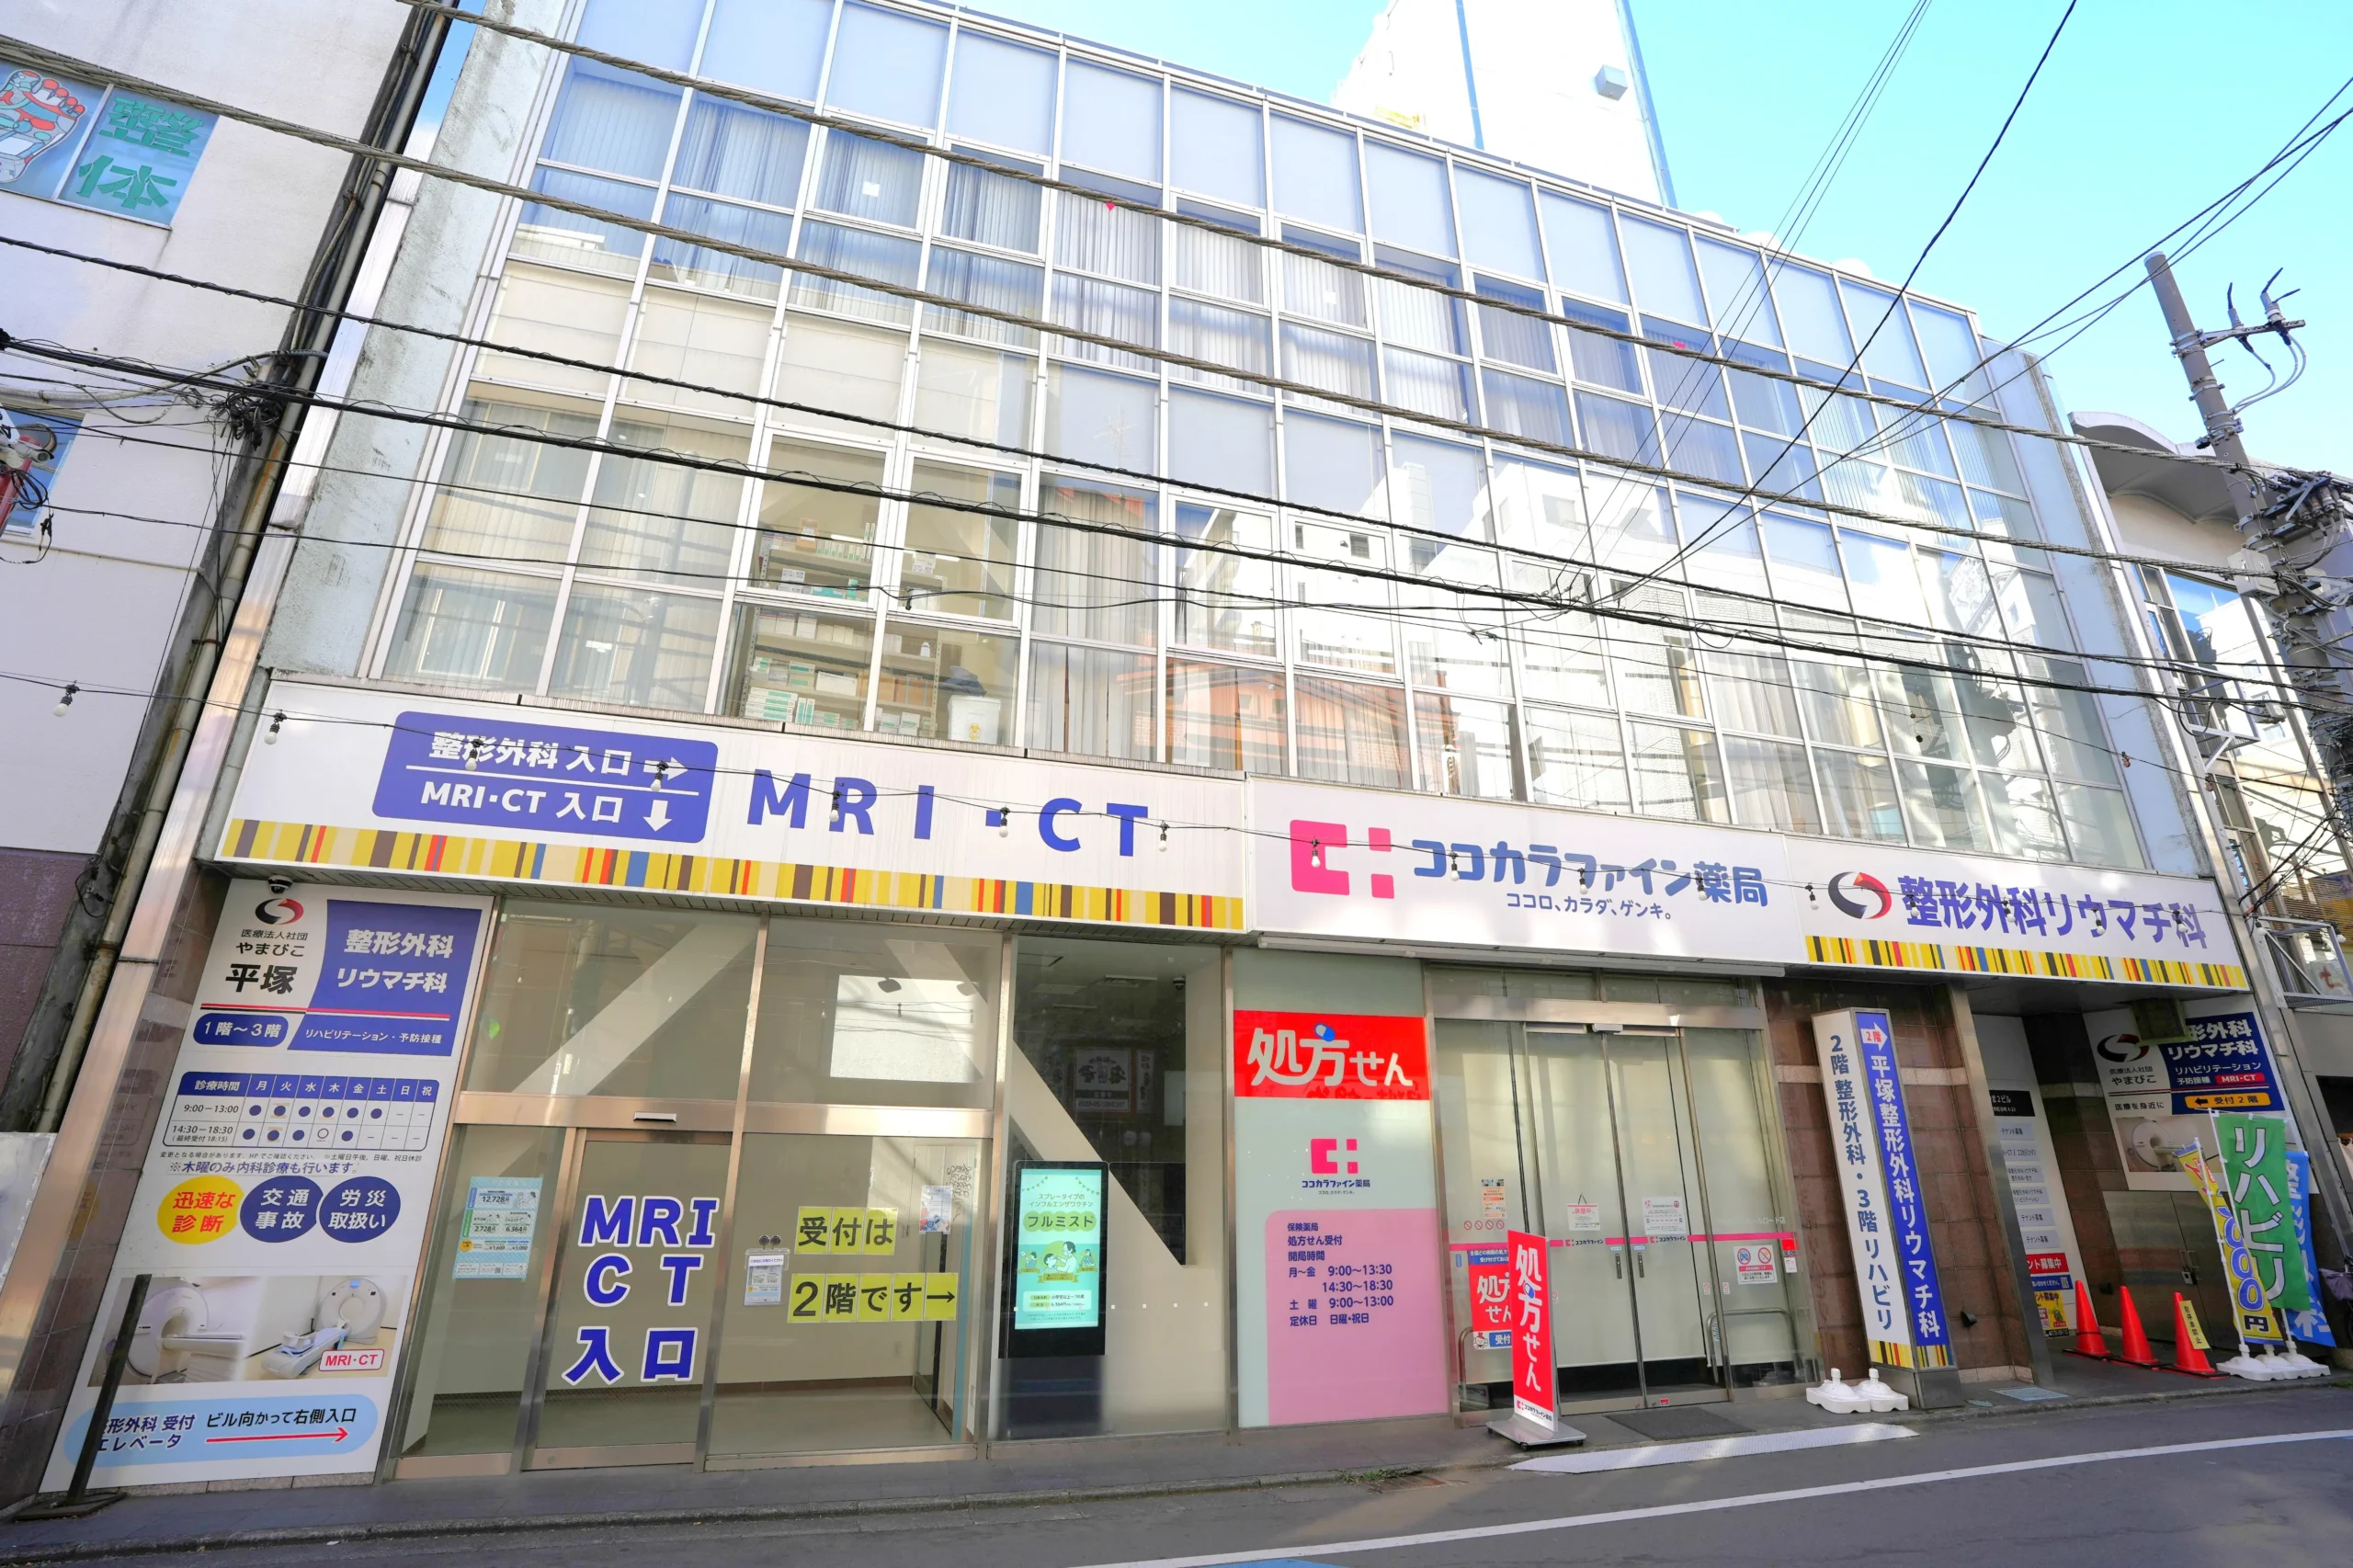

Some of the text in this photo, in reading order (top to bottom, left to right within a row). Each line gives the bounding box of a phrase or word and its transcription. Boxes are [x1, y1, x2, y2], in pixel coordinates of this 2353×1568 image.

[429, 732, 631, 776] 整形外科 入口
[557, 792, 622, 823] 入口
[1413, 839, 1768, 906] ココカラファイン薬局
[1506, 893, 1671, 920] ココロ、カラダ、ゲンキ。
[1897, 875, 2206, 949] 整形外科リウマチ科
[241, 929, 307, 940] 医療法人社団
[344, 929, 454, 958] 整形外科
[236, 942, 304, 957] やまびこ
[225, 964, 298, 994] 平塚
[336, 968, 448, 993] リウマチ科
[1866, 1030, 1881, 1043] 2階
[2188, 1018, 2253, 1041] 形外科
[1247, 1023, 1413, 1086] 処方せん
[2167, 1040, 2259, 1061] リウマチ科
[2109, 1066, 2153, 1075] 医療法人社団
[2175, 1062, 2262, 1075] リハビリテーション
[194, 1080, 432, 1096] 診療時間 月 火 水 木 金 土 日 祝
[2111, 1075, 2157, 1085] やまびこ
[2177, 1076, 2211, 1085] 予防接種
[2114, 1102, 2165, 1111] 医療を身近に
[1302, 1179, 1370, 1188] ココカラファイン薬局
[173, 1191, 235, 1210] 迅速な
[261, 1188, 308, 1207] 交通
[340, 1189, 386, 1207] 労災
[1871, 1055, 1941, 1339] 平塚整形外科リウマチ科
[172, 1214, 224, 1233] 診断
[255, 1210, 305, 1230] 事故
[328, 1211, 387, 1229] 取扱い
[578, 1196, 720, 1247] MRI
[1028, 1215, 1094, 1228] フルミスト
[2234, 1127, 2285, 1301] リハビリ
[799, 1216, 893, 1246] 受付は
[1288, 1222, 1319, 1232] 保険薬局
[1288, 1234, 1343, 1246] 処方せん受付
[1288, 1251, 1325, 1262] 開局時間
[1290, 1316, 1317, 1326] 定休日
[1516, 1244, 1542, 1392] 処方せん
[562, 1326, 698, 1384] 入口
[103, 1407, 356, 1433] 形外科 受付 ビル向かって右側入口
